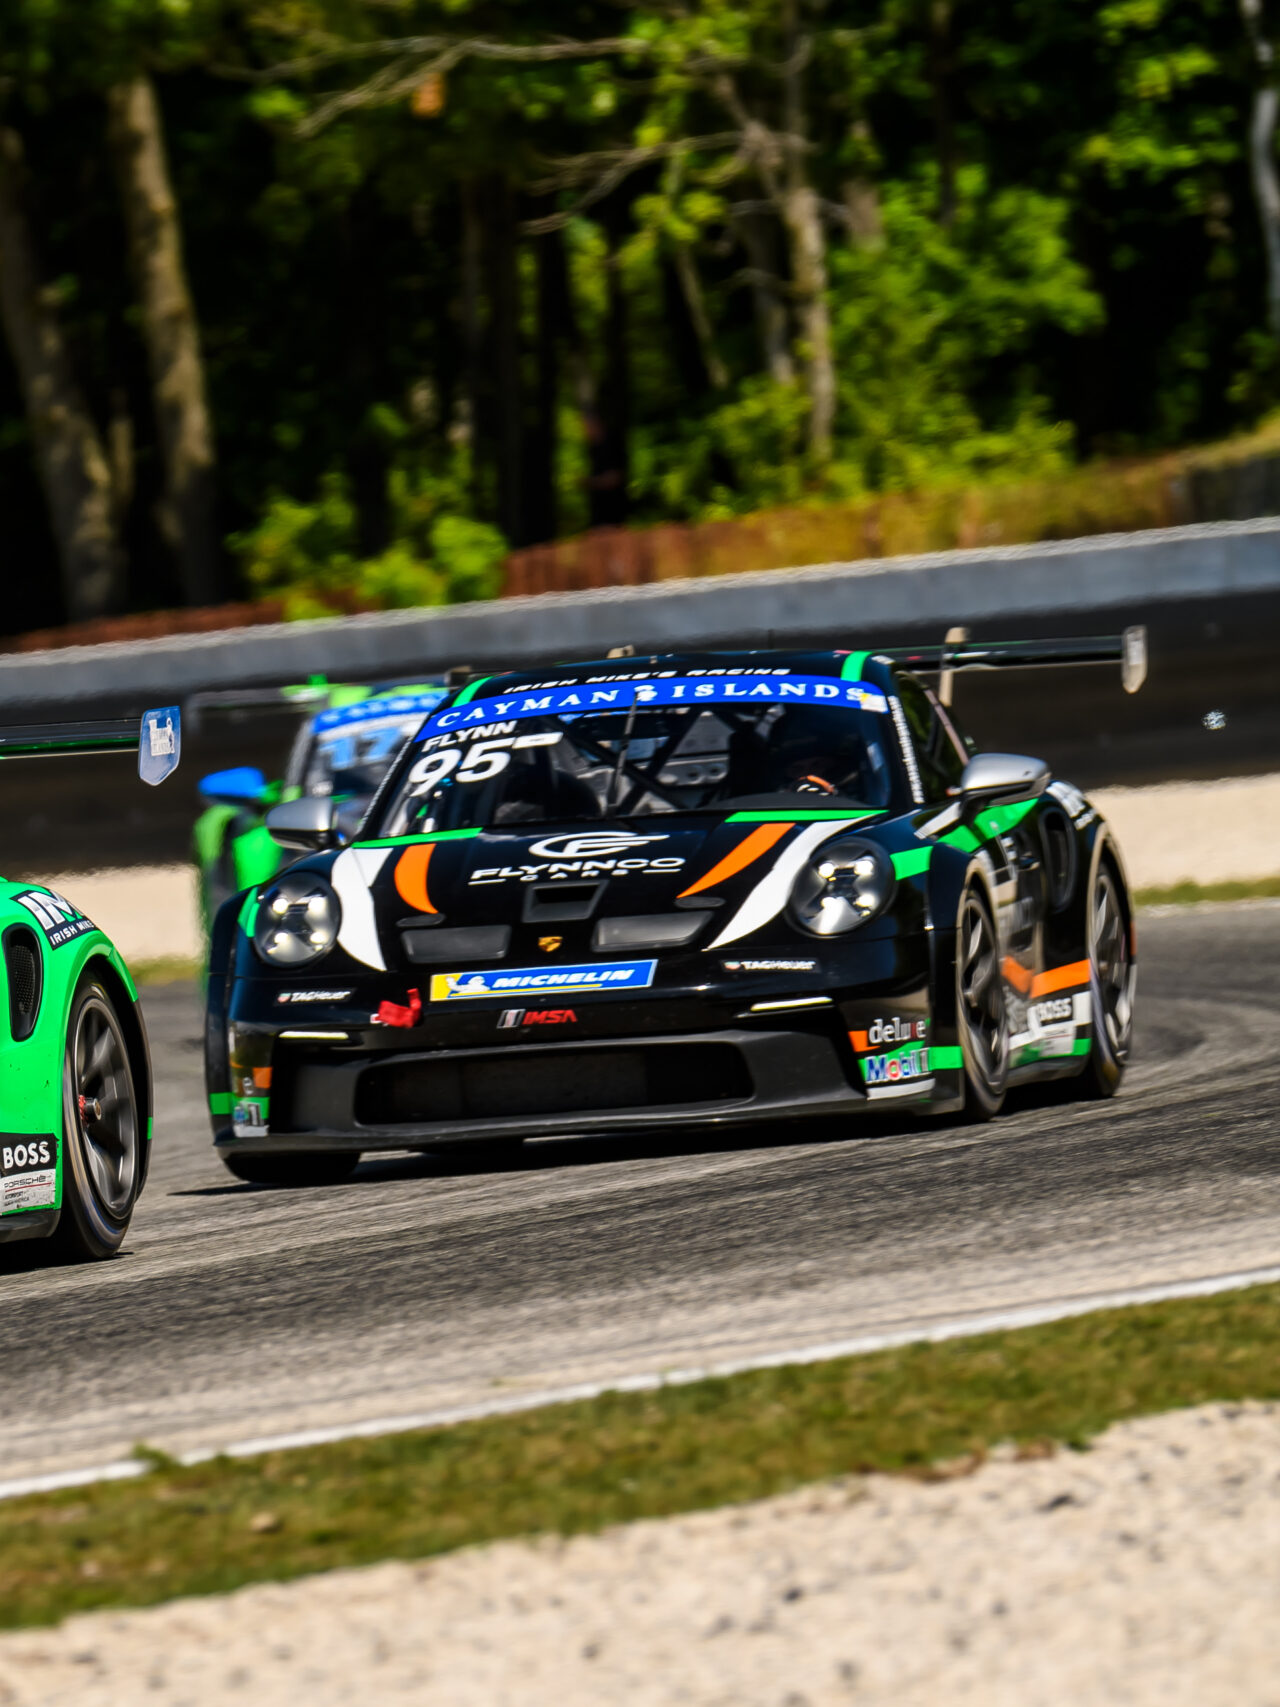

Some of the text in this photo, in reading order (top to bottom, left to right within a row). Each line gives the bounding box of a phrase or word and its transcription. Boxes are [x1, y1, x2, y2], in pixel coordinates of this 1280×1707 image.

[502, 678, 578, 695] IRISH
[686, 668, 791, 677] RACING
[436, 689, 620, 728] CAYMAN
[671, 682, 866, 702] ISLANDS
[421, 720, 518, 752] FLYNN
[408, 737, 517, 798] 95
[470, 857, 686, 880] FLYNNCO
[49, 925, 78, 946] IRISH
[492, 969, 635, 988] MICHELIN
[522, 1009, 578, 1025] IMSA
[3, 1141, 50, 1169] BOSS
